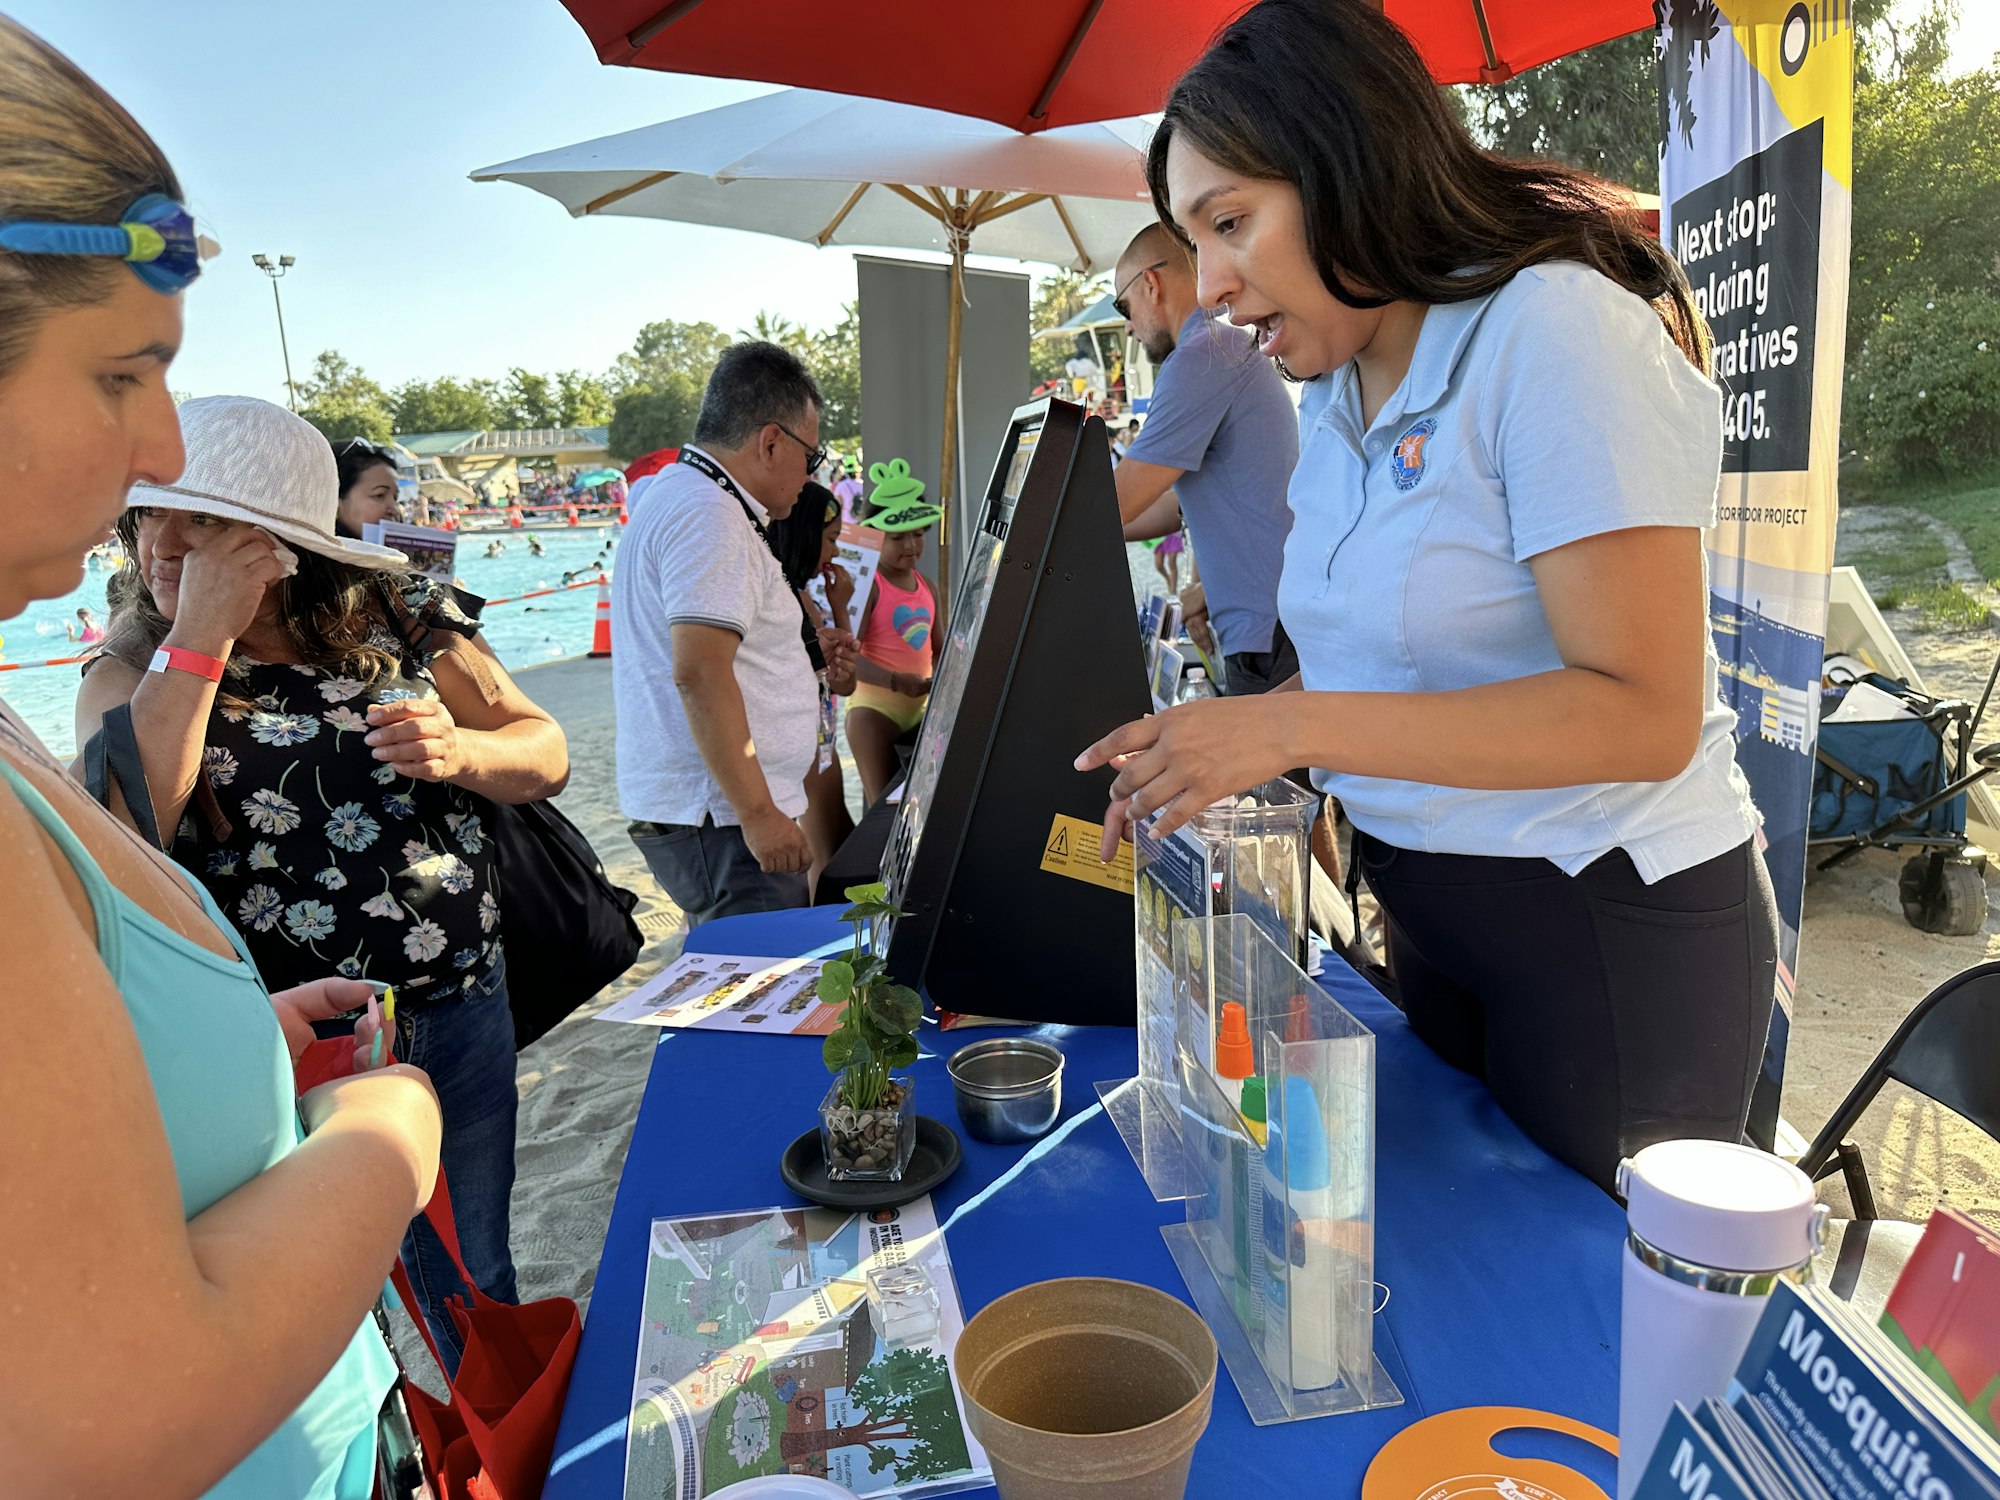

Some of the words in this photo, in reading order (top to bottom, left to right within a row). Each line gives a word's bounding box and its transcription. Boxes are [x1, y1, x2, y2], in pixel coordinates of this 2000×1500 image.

[1677, 208, 1723, 266] Next
[1726, 191, 1776, 247] stop:
[1694, 260, 1769, 319] ploring
[1723, 389, 1770, 442] 405.
[1720, 506, 1762, 522] CORRIDOR
[1765, 508, 1808, 528] PROJECT
[879, 1225, 890, 1233] IN
[890, 1224, 902, 1237] ARE
[881, 1233, 893, 1251] YOUR
[893, 1237, 904, 1251] YOU
[840, 1411, 848, 1424] holes
[1777, 1386, 1807, 1427] handy
[1801, 1420, 1832, 1455] guide
[725, 1424, 733, 1440] Ponds
